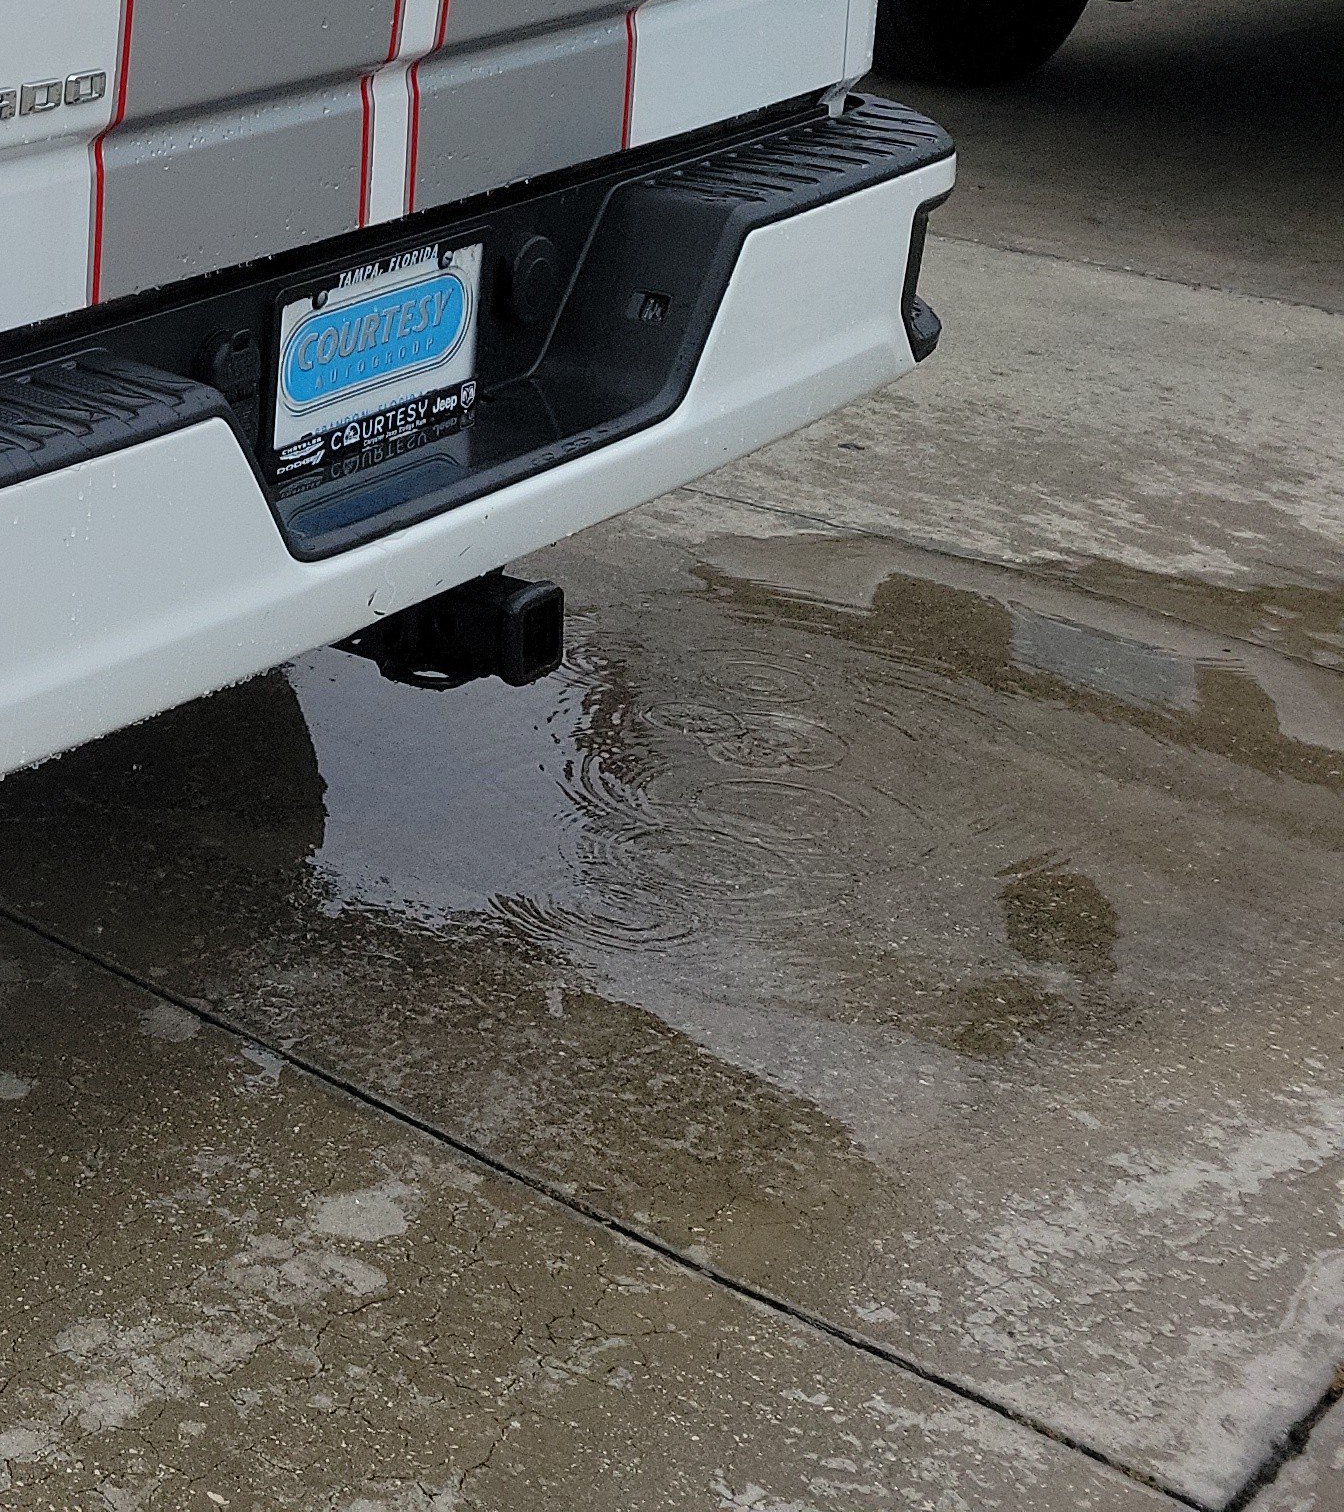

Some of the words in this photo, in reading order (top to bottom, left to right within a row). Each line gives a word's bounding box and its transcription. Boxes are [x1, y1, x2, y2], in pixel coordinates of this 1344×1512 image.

[338, 262, 384, 288] TAMPA,
[388, 244, 439, 273] FLORIDA
[297, 288, 454, 372] COURTESY
[315, 337, 435, 390] AUTOGROUP
[331, 399, 429, 450] COURTESY
[433, 395, 458, 414] Jeep
